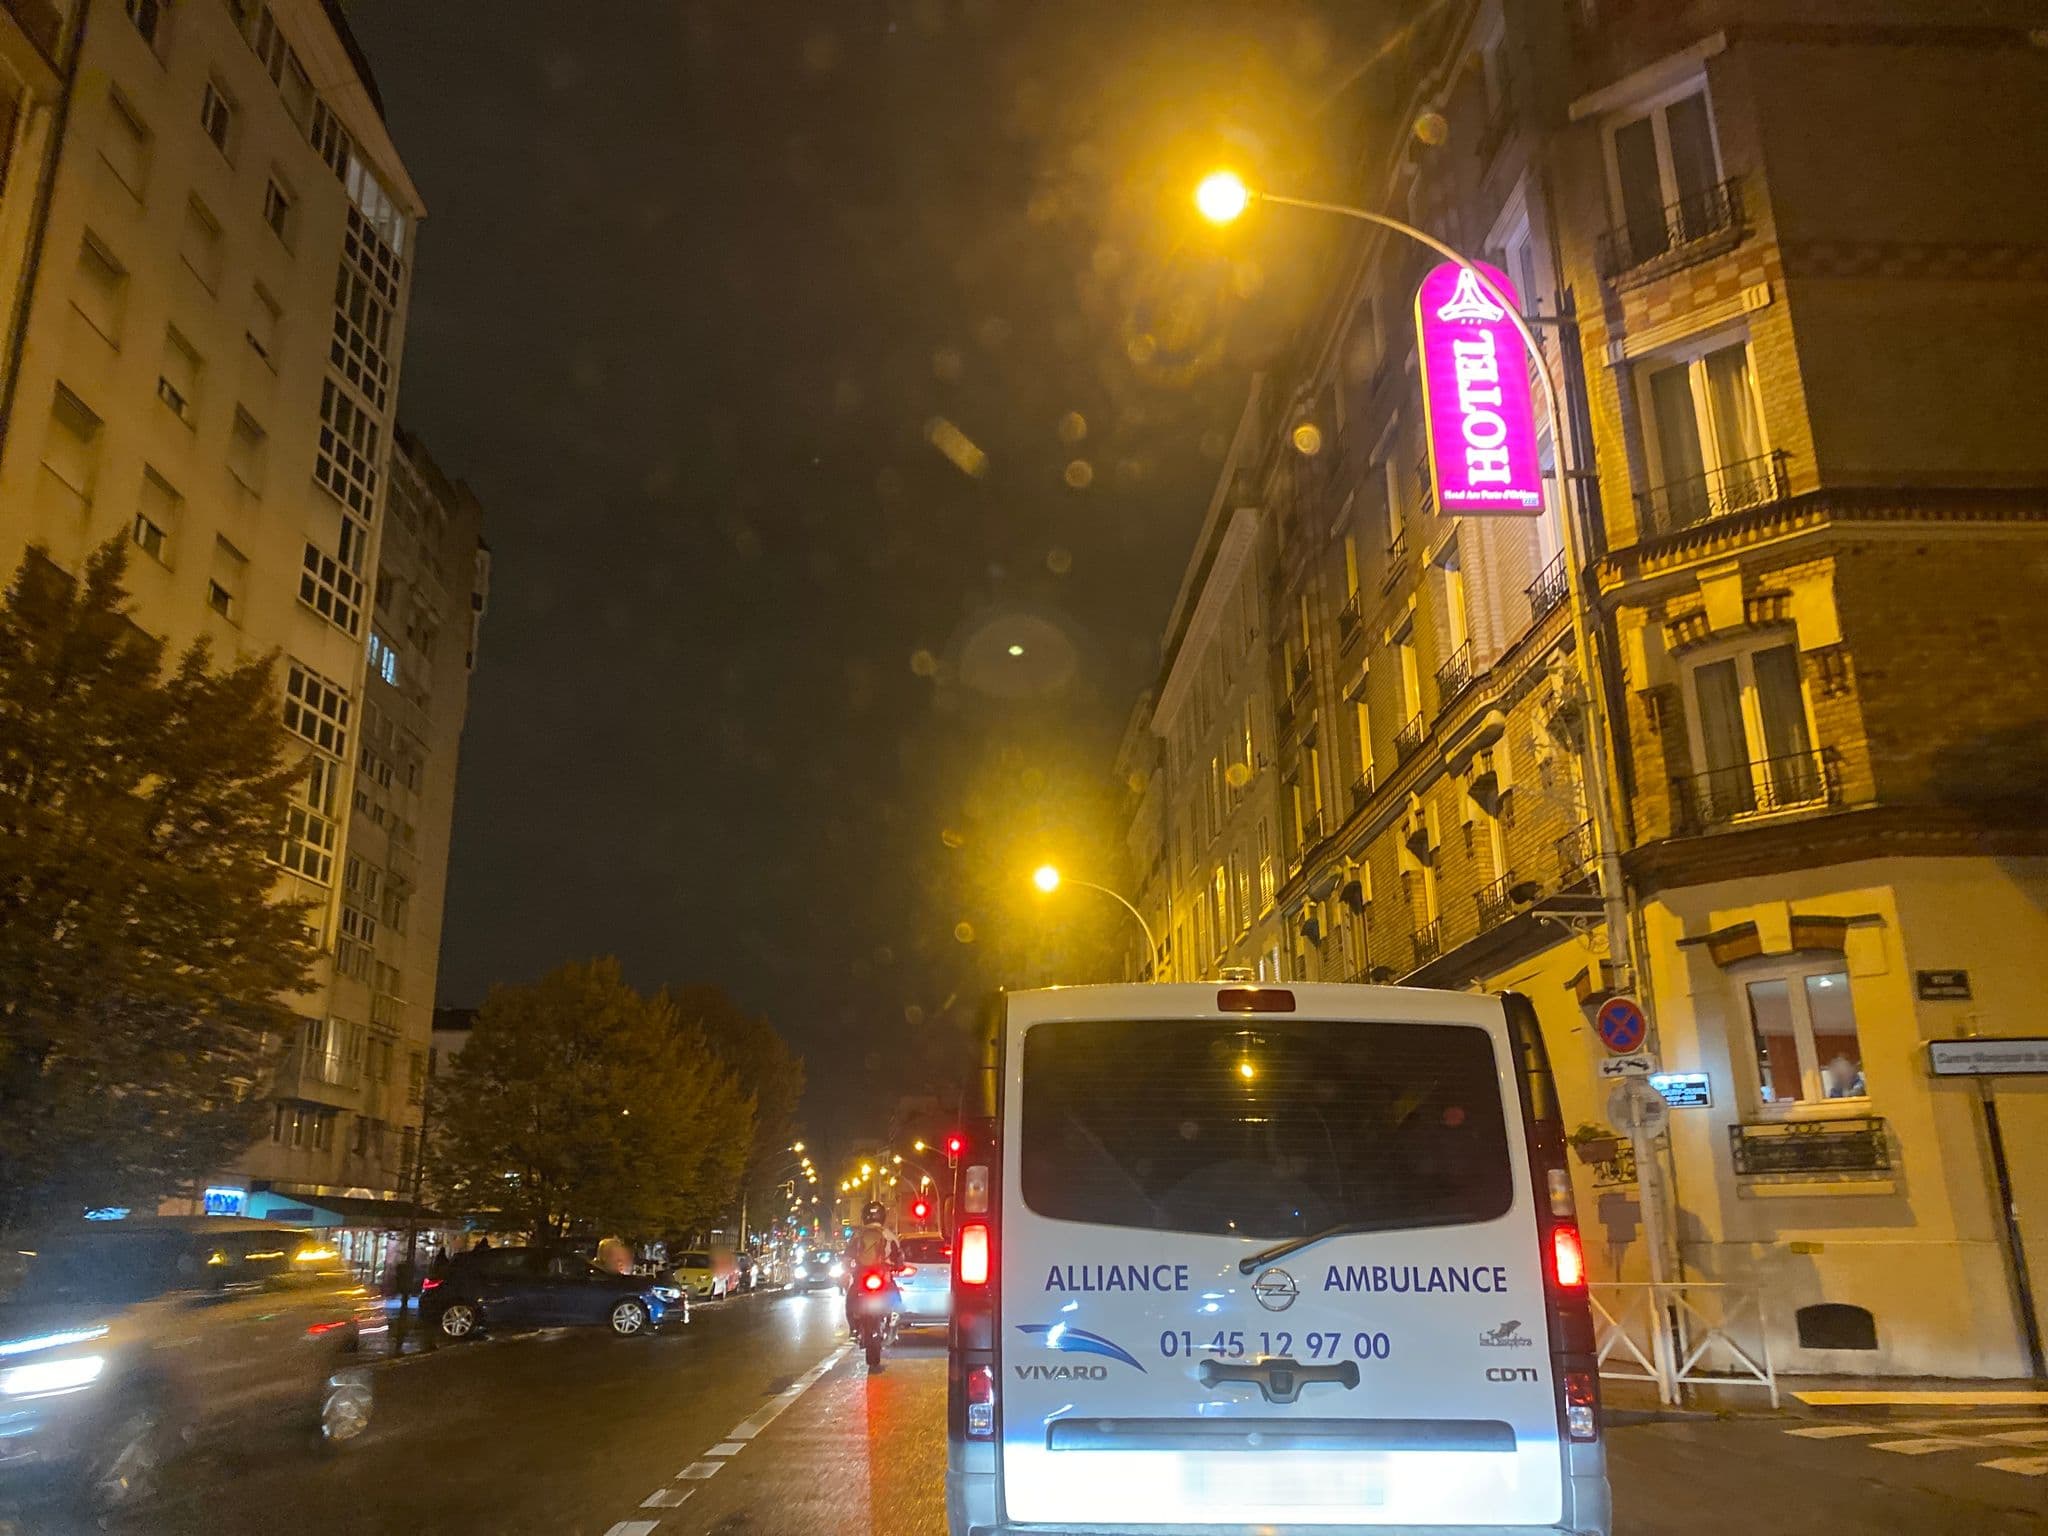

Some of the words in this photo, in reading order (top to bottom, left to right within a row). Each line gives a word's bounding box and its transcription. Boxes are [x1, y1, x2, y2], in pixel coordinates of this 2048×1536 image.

[1453, 329, 1512, 486] HOTEL
[1045, 1265, 1189, 1292] ALLIANCE
[1324, 1265, 1507, 1293] AMBULANCE
[1160, 1330, 1192, 1358] 01
[1208, 1330, 1244, 1358] 45
[1259, 1331, 1293, 1358] 12
[1306, 1331, 1342, 1359] 97
[1353, 1332, 1391, 1360] 00
[1015, 1365, 1108, 1381] VIVARO
[1485, 1367, 1539, 1382] CDTI
